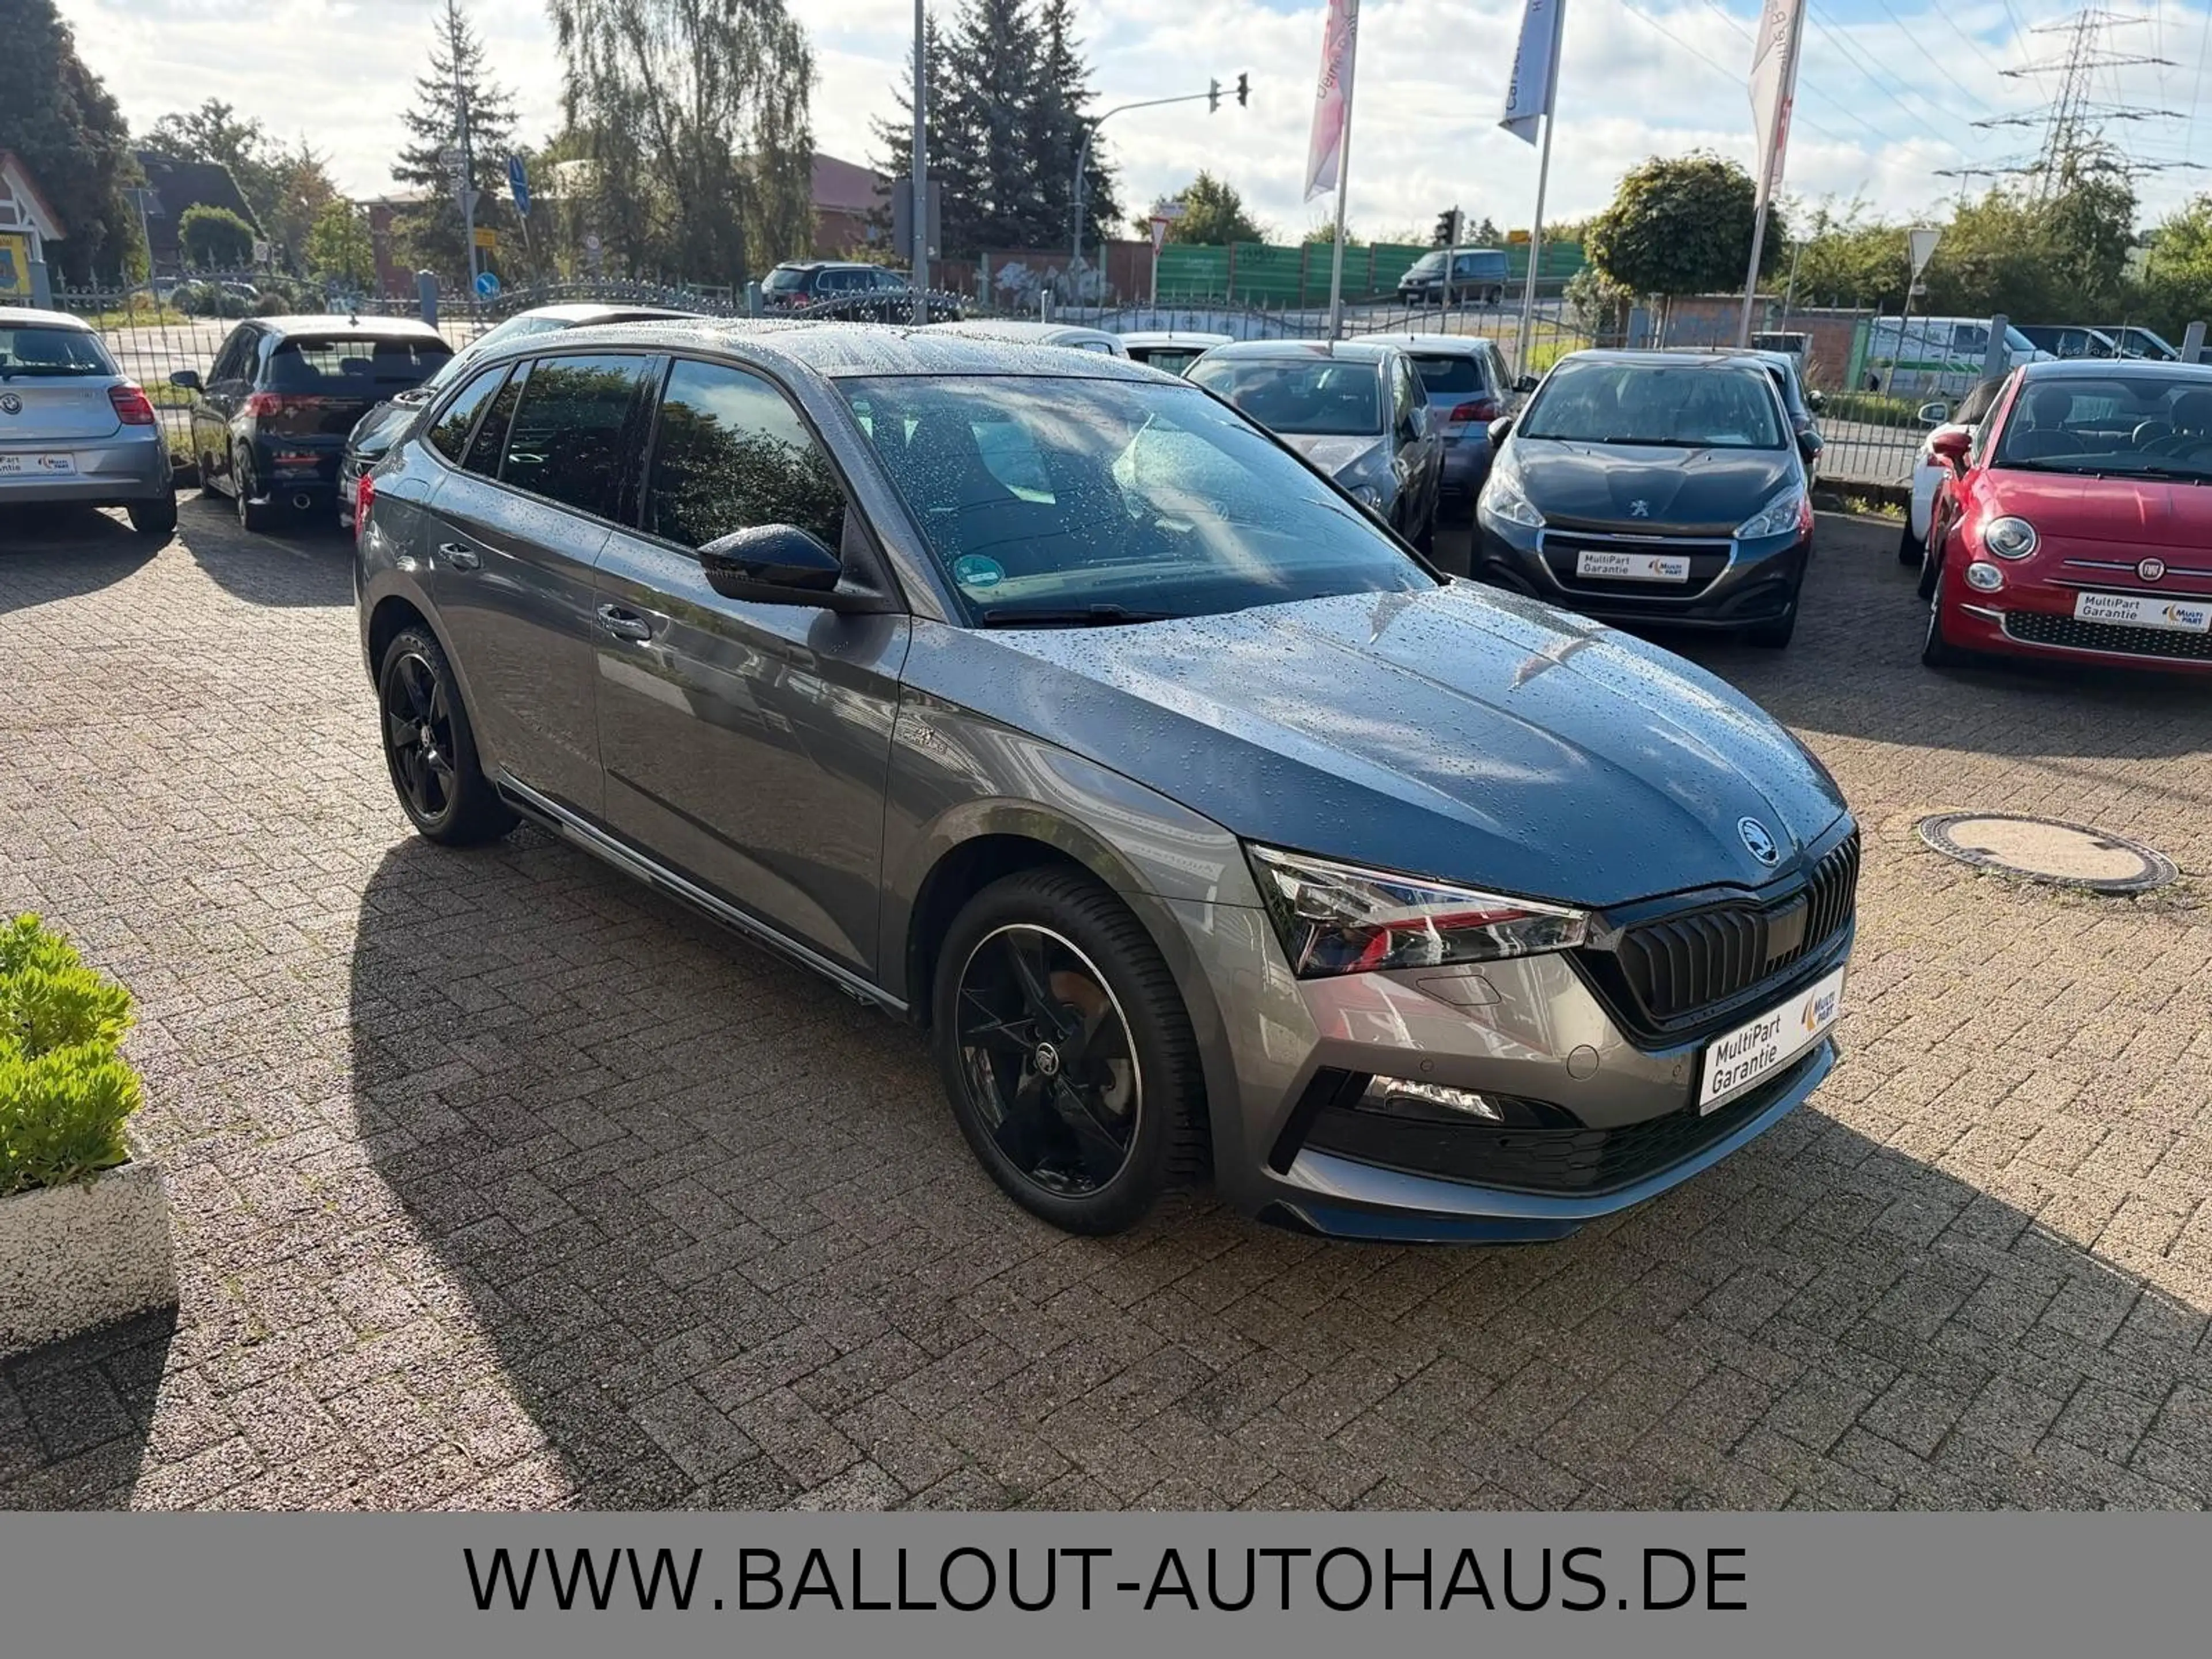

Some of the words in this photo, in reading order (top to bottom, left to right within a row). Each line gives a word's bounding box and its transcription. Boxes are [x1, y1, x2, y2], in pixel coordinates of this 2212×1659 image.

[1585, 555, 1630, 565] MultiPart
[1584, 564, 1628, 574] Garantie
[2085, 596, 2140, 609] MultiPart
[2083, 605, 2137, 620] Garantie
[1715, 1014, 1781, 1067] MultiPart
[1712, 1044, 1778, 1094] Garantie
